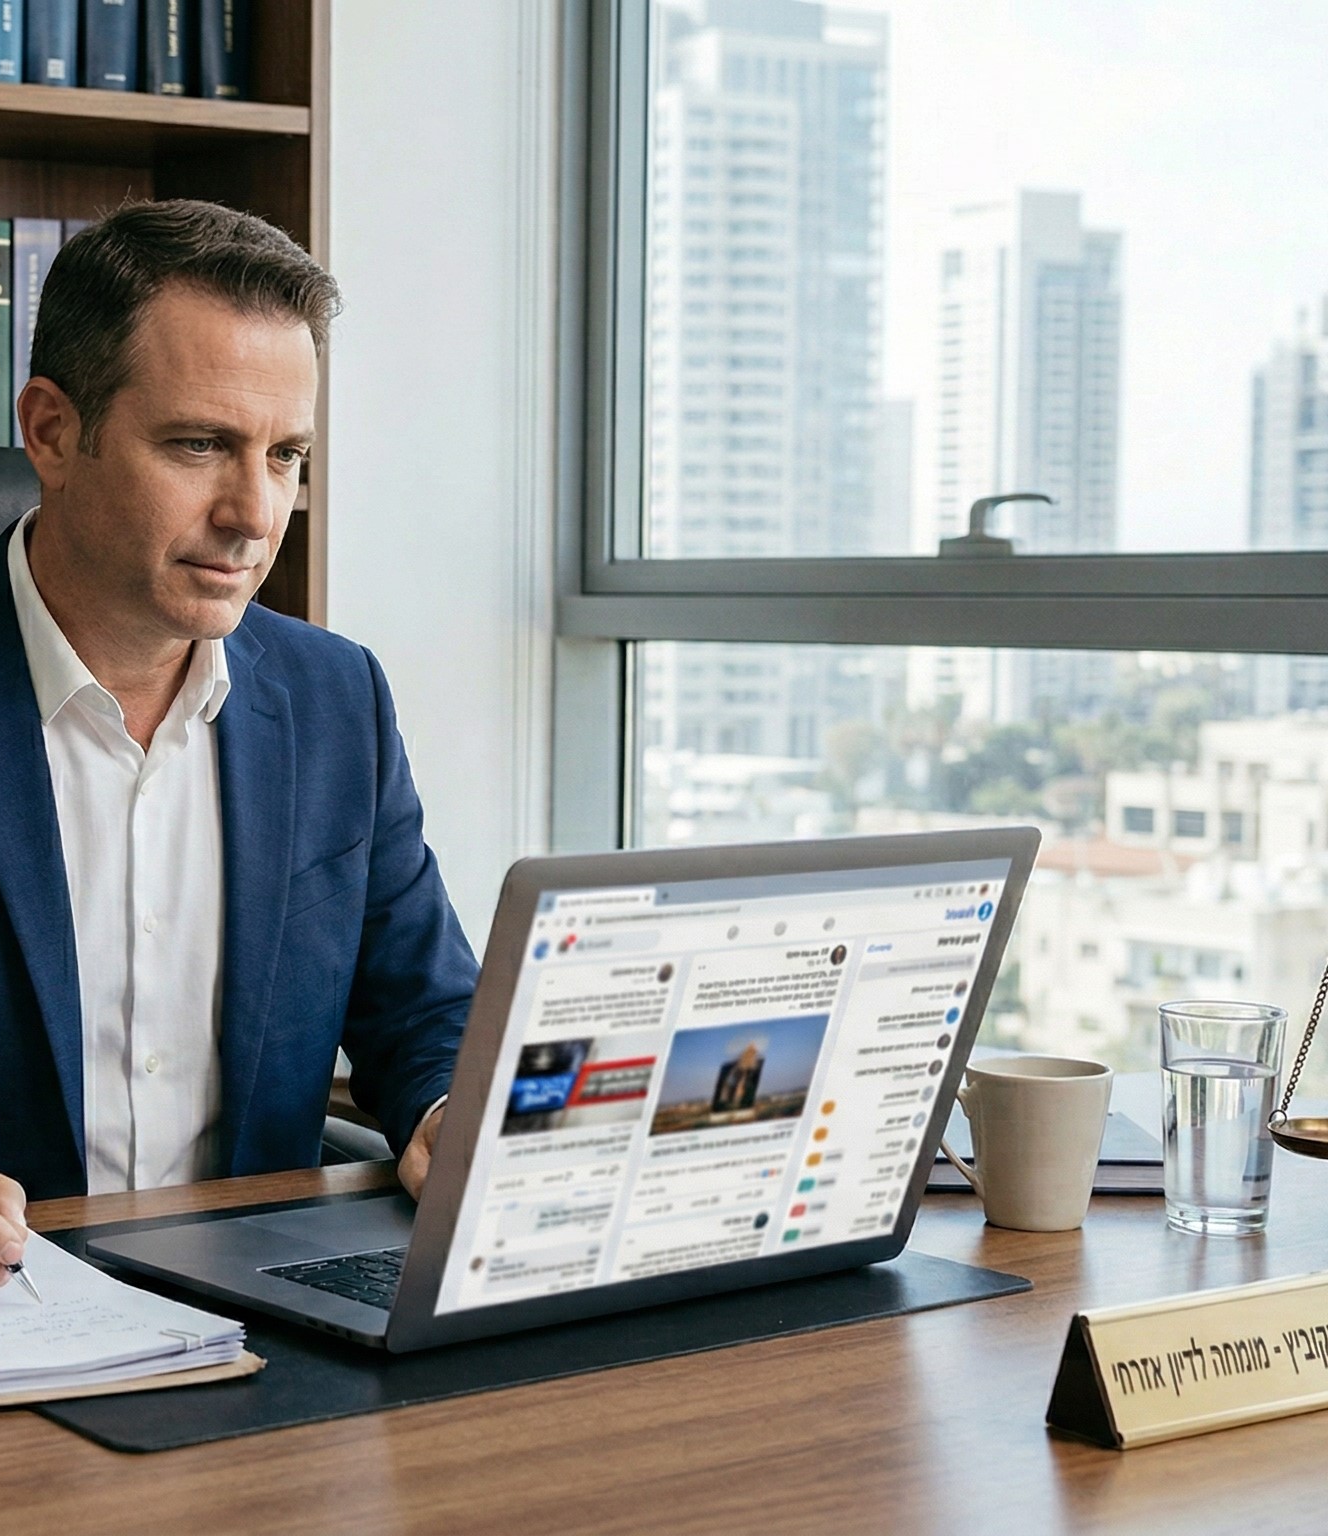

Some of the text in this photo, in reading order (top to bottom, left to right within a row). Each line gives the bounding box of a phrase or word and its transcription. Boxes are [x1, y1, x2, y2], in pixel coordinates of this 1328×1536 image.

[1111, 1325, 1328, 1397] קוביץ - מומחה לדיון אזרחי
